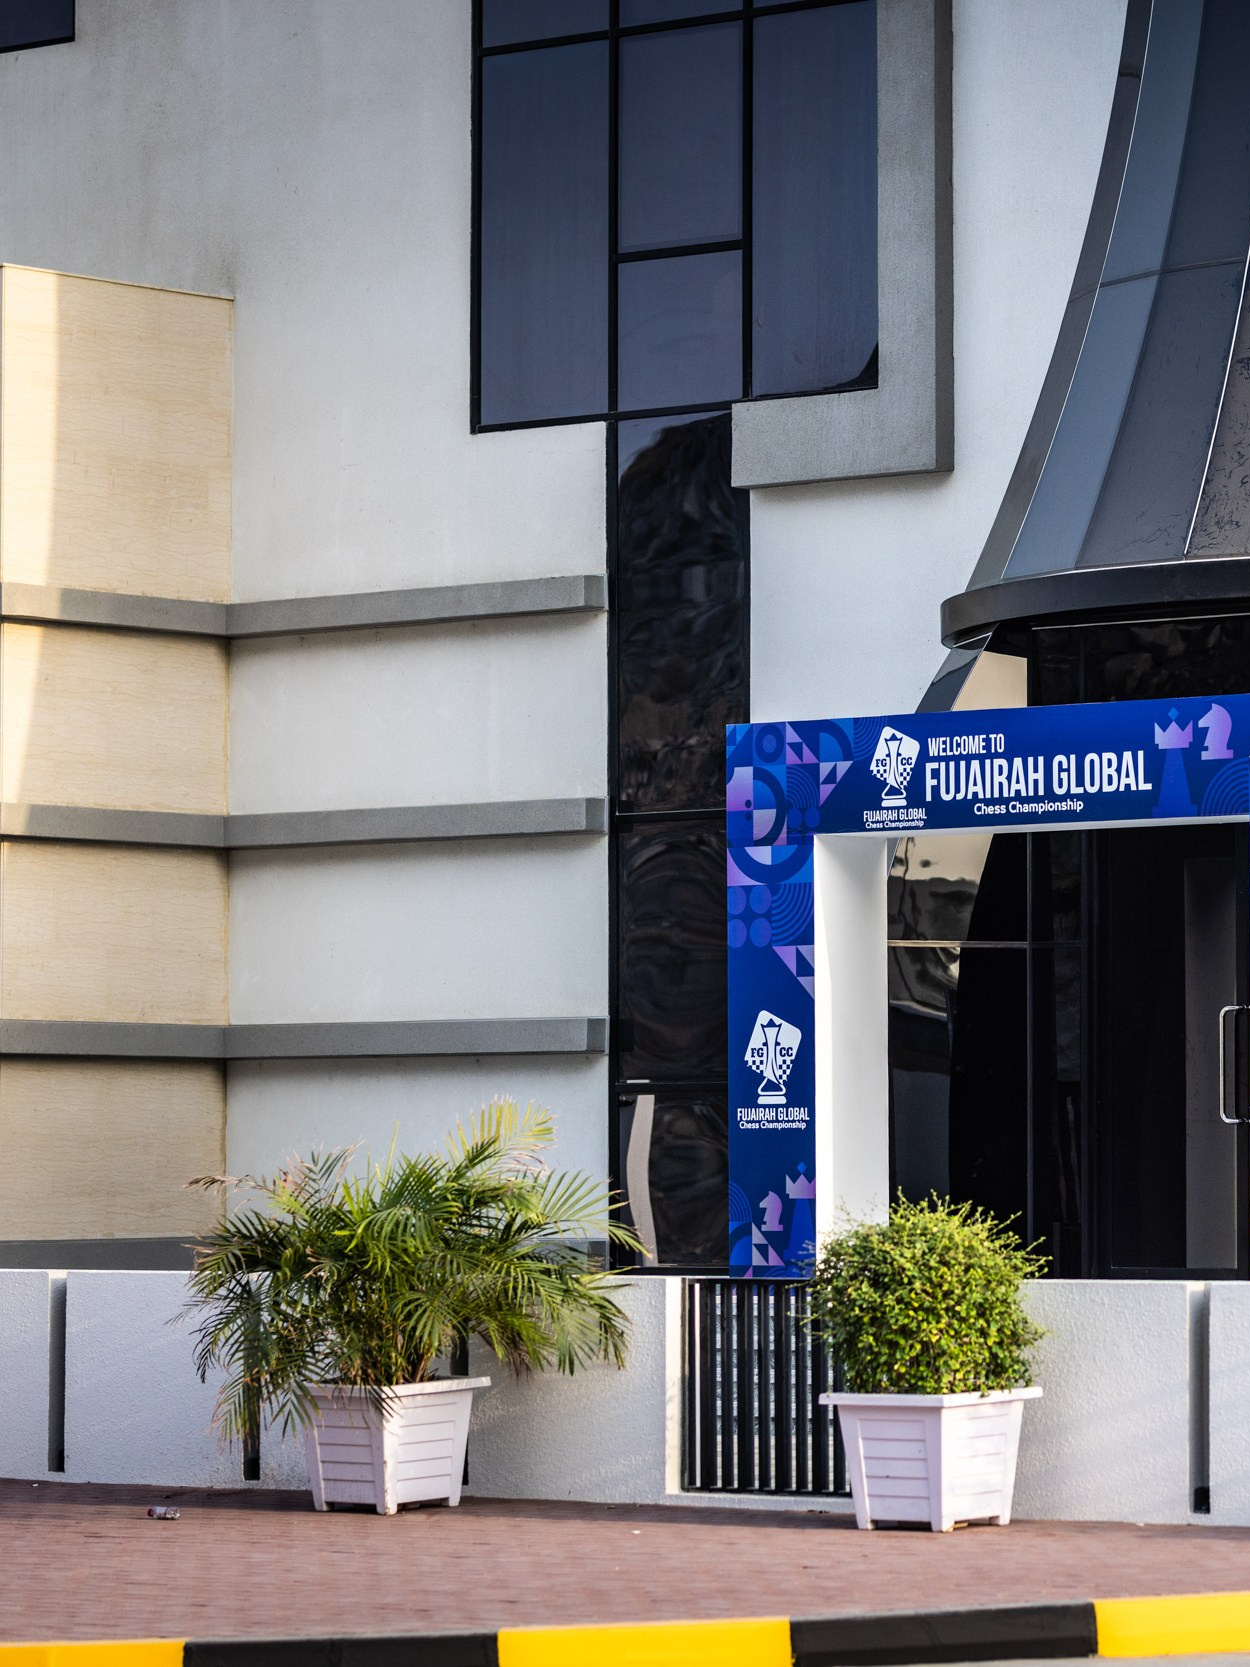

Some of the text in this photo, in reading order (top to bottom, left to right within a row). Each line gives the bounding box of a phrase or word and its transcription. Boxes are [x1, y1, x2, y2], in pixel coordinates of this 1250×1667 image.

[928, 733, 1005, 757] WELCOME TO
[875, 757, 913, 768] FG CC
[925, 750, 1152, 802] FUJAIRAH GLOBAL
[974, 799, 1084, 815] Chess Championship
[863, 808, 927, 822] FUJAIRAH GLOBAL
[865, 820, 924, 829] Chess Championship
[751, 1047, 793, 1058] FG CC
[737, 1107, 810, 1121] FUJAIRAH GLOBAL
[739, 1121, 806, 1130] Chess Championship
